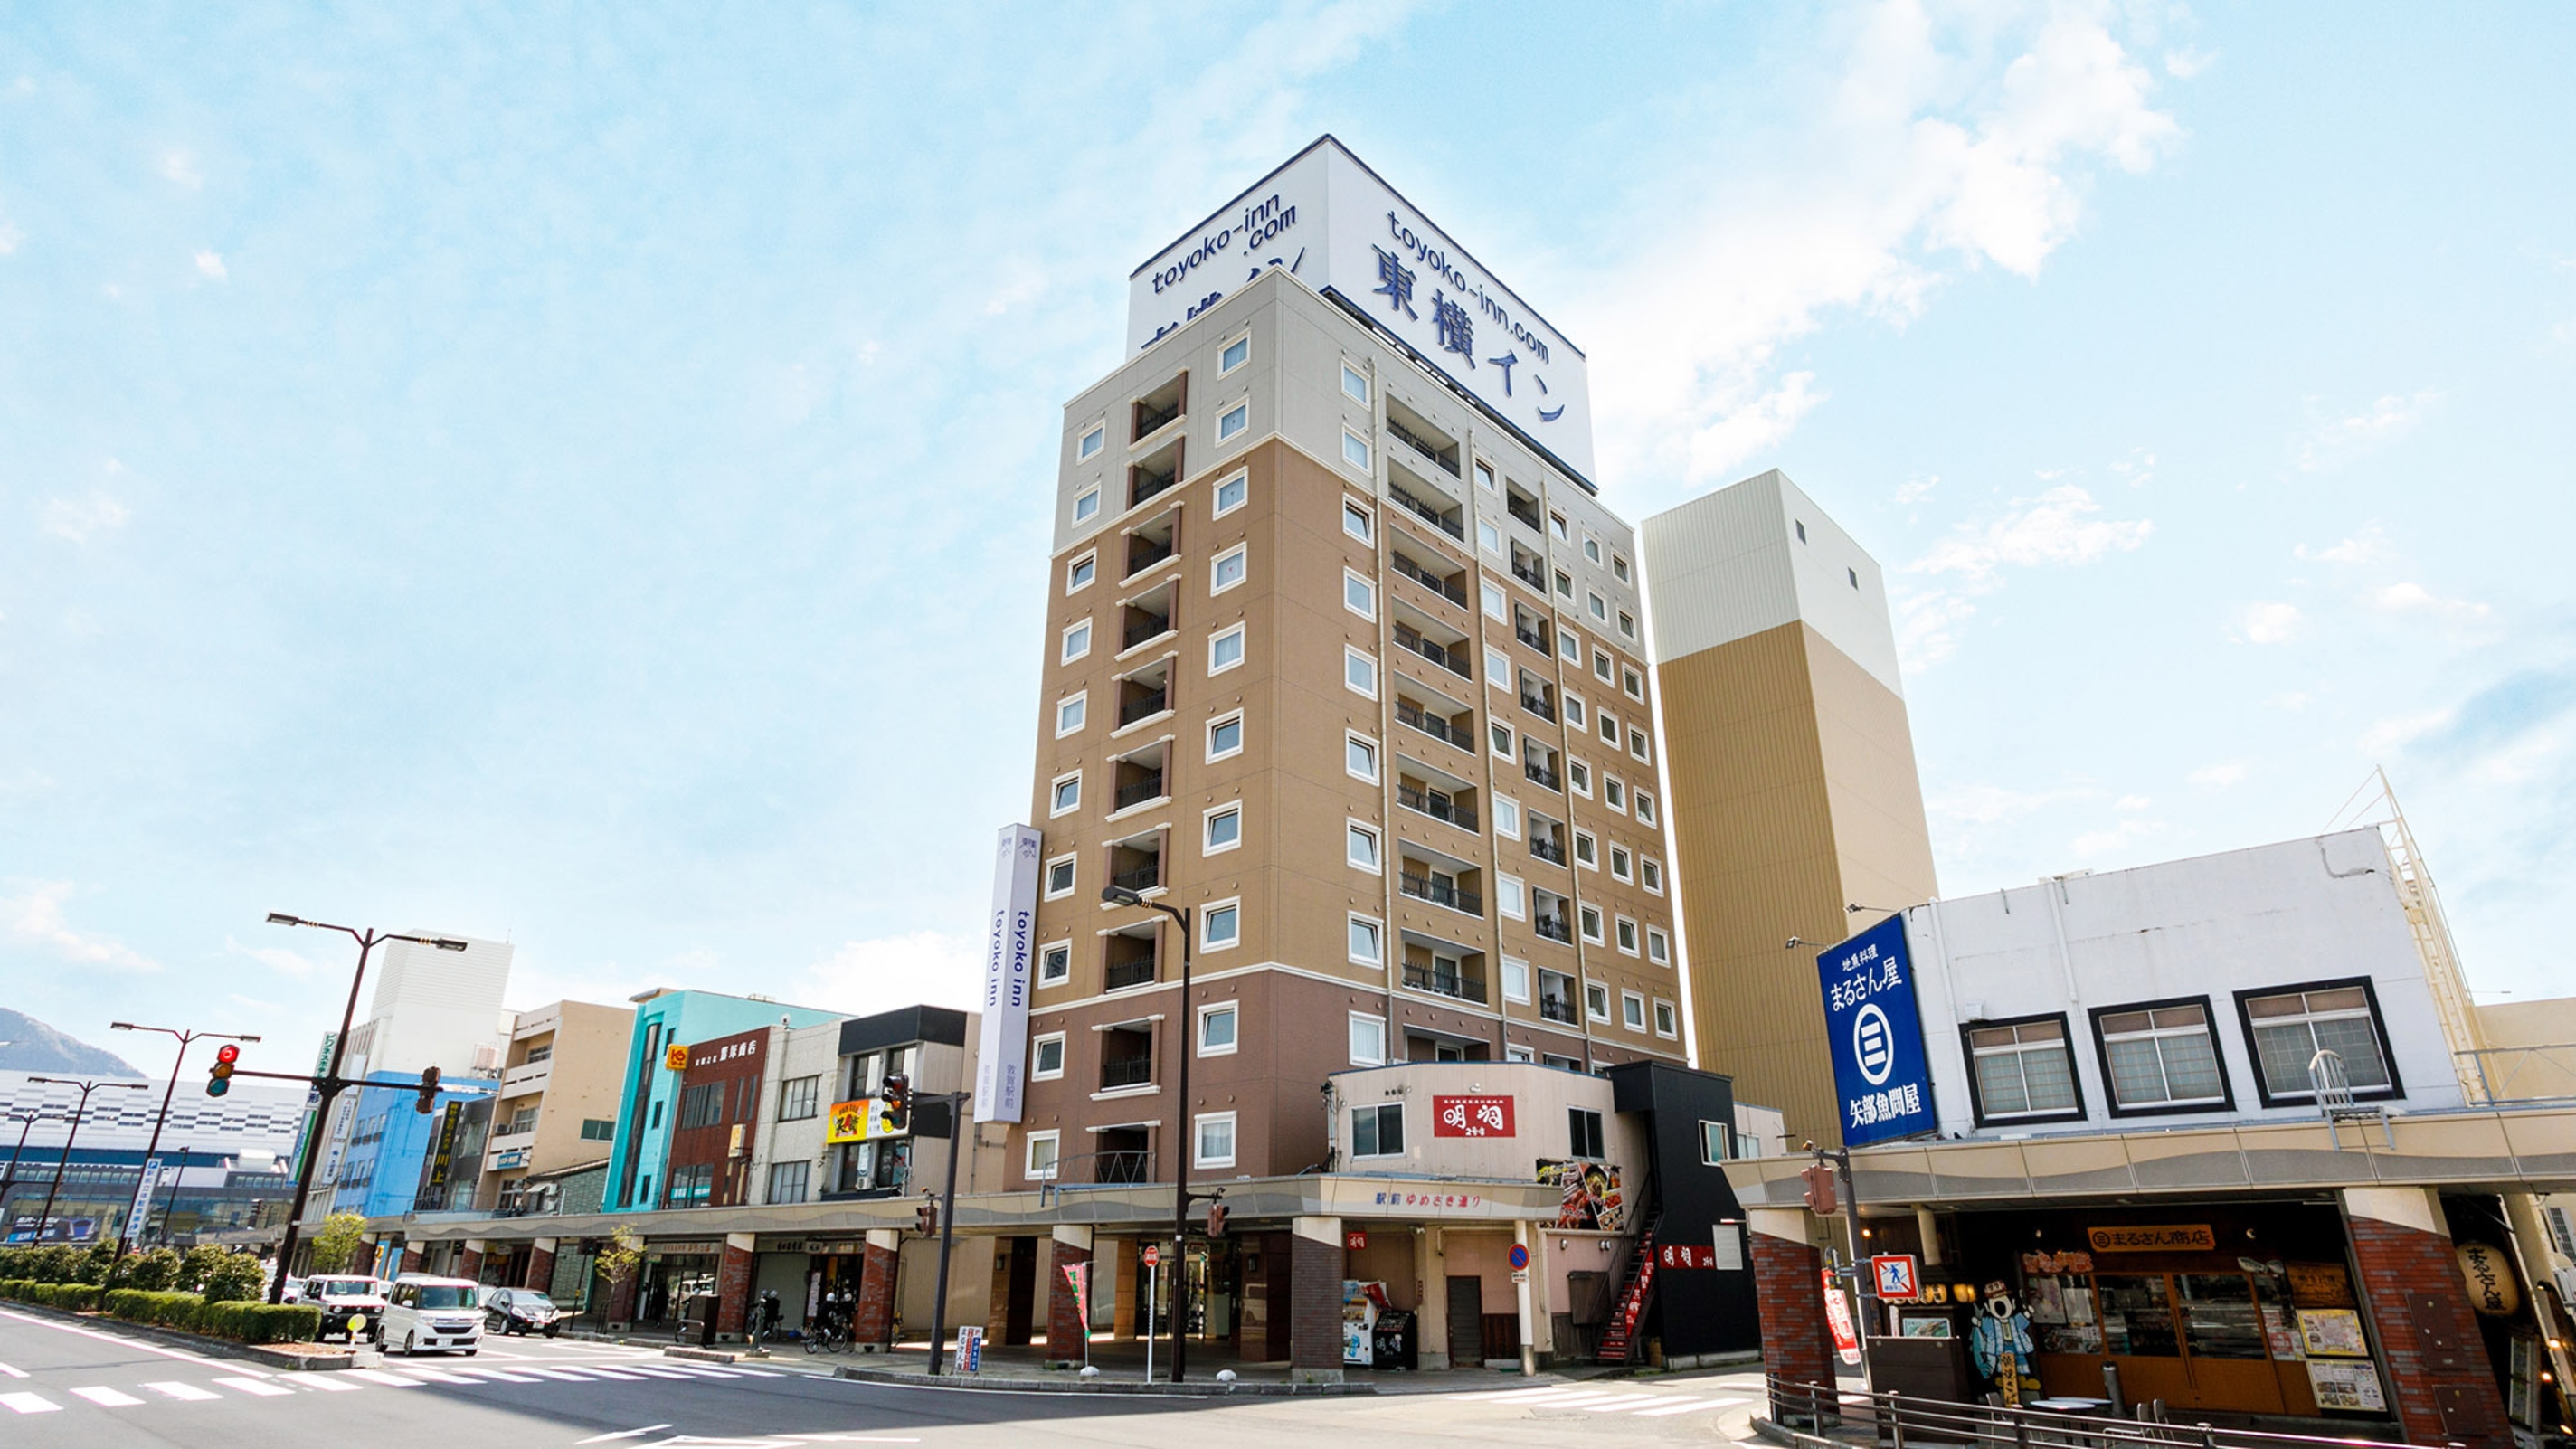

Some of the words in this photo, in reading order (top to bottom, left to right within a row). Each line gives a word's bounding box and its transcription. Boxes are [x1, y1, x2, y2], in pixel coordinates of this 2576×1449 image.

[1151, 194, 1280, 294] toyoko-inn
[1243, 205, 1296, 256] .com
[1387, 211, 1550, 364] toyoko-inn.com
[1371, 243, 1565, 422] 東横イン
[992, 909, 1005, 972] toyoko
[1014, 910, 1029, 972] toyoko
[1842, 943, 1879, 972] 地魚料理
[990, 978, 1000, 1007] inn
[1011, 978, 1026, 1007] inn
[1831, 956, 1902, 1011] まるさん屋
[1850, 1083, 1922, 1129] 矢部魚問屋
[2112, 1230, 2210, 1246] まるさん商店
[2467, 1247, 2506, 1311] まるさん屋
